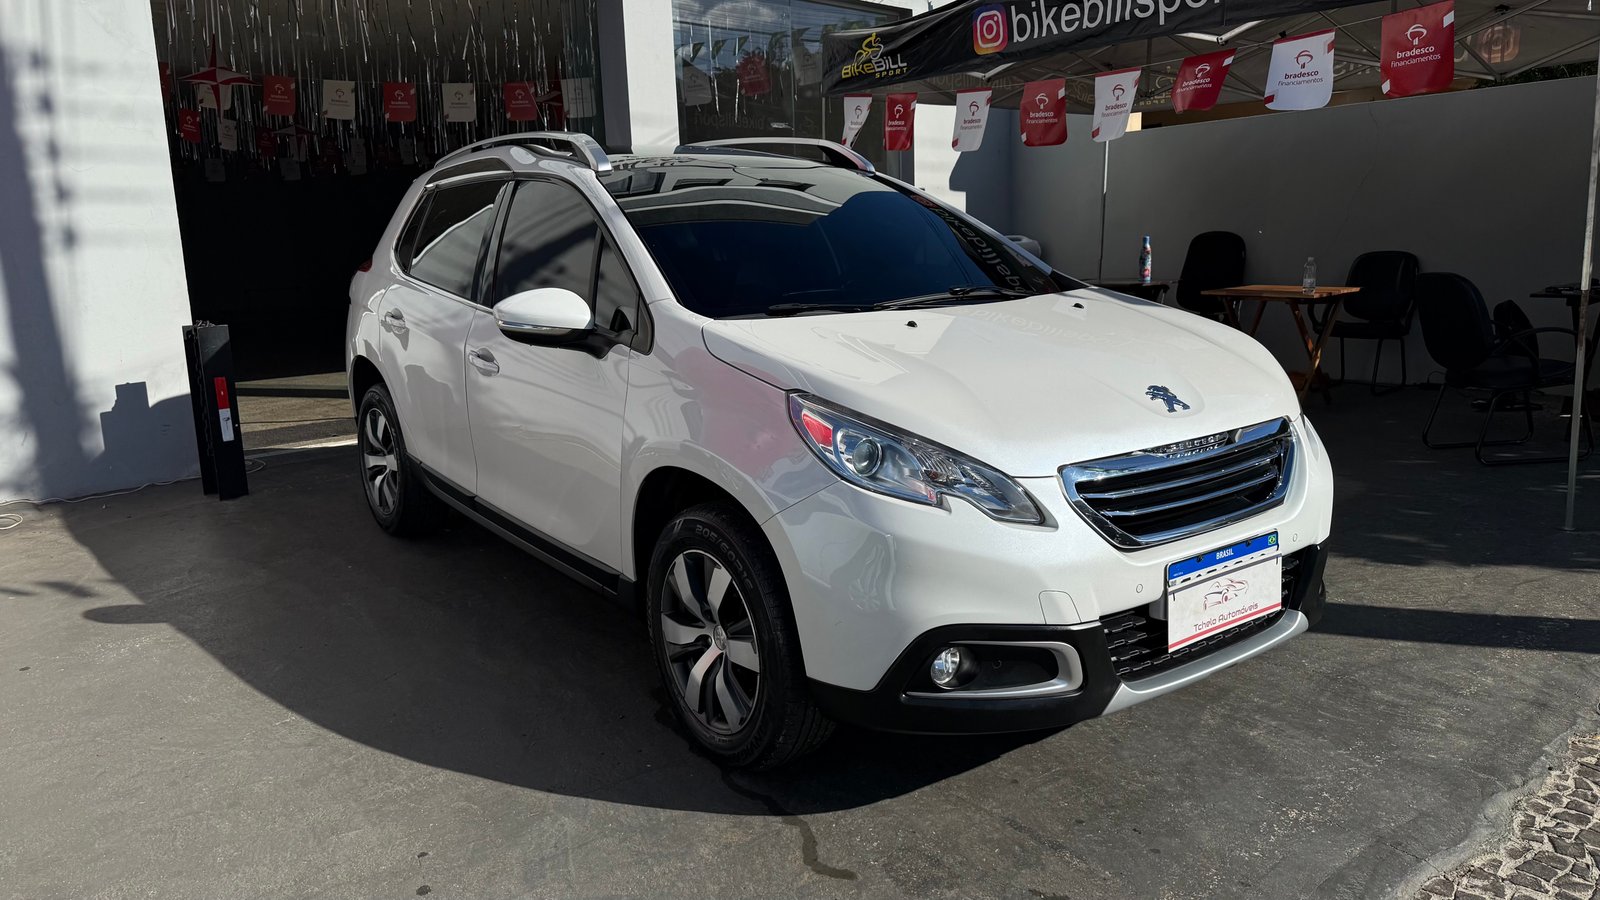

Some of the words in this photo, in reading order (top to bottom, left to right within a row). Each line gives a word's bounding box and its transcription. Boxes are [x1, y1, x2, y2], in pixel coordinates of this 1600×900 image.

[1010, 0, 1220, 43] bikebillsp
[1396, 46, 1435, 59] bradesco
[1390, 53, 1441, 68] financiamentos
[875, 67, 908, 79] SPORT
[1284, 70, 1319, 80] bradesco
[1182, 77, 1211, 87] bradesco
[1277, 77, 1324, 87] financiamentos
[1104, 103, 1128, 111] bradesco
[1215, 548, 1234, 560] BRASIL
[1218, 602, 1259, 623] Automóveis
